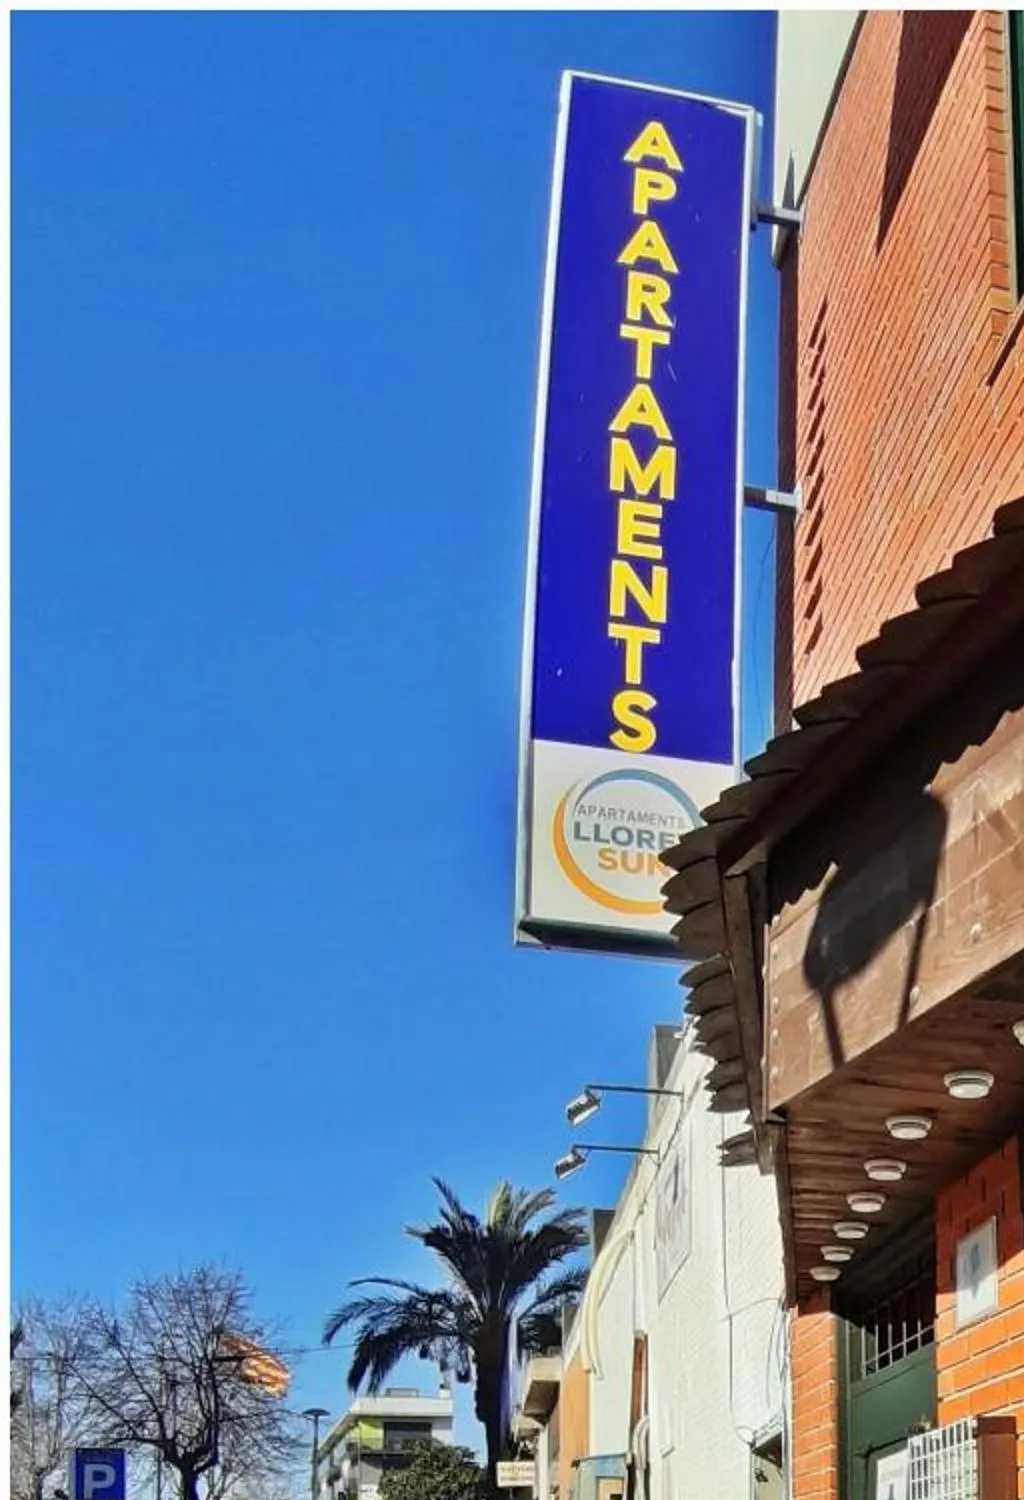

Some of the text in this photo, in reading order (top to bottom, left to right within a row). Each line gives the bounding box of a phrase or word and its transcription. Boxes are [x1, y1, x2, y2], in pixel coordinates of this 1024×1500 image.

[608, 120, 684, 753] APARTAMENTS
[577, 804, 686, 829] APARTAMENTS
[573, 821, 681, 852] LLORE
[83, 1463, 116, 1500] P
